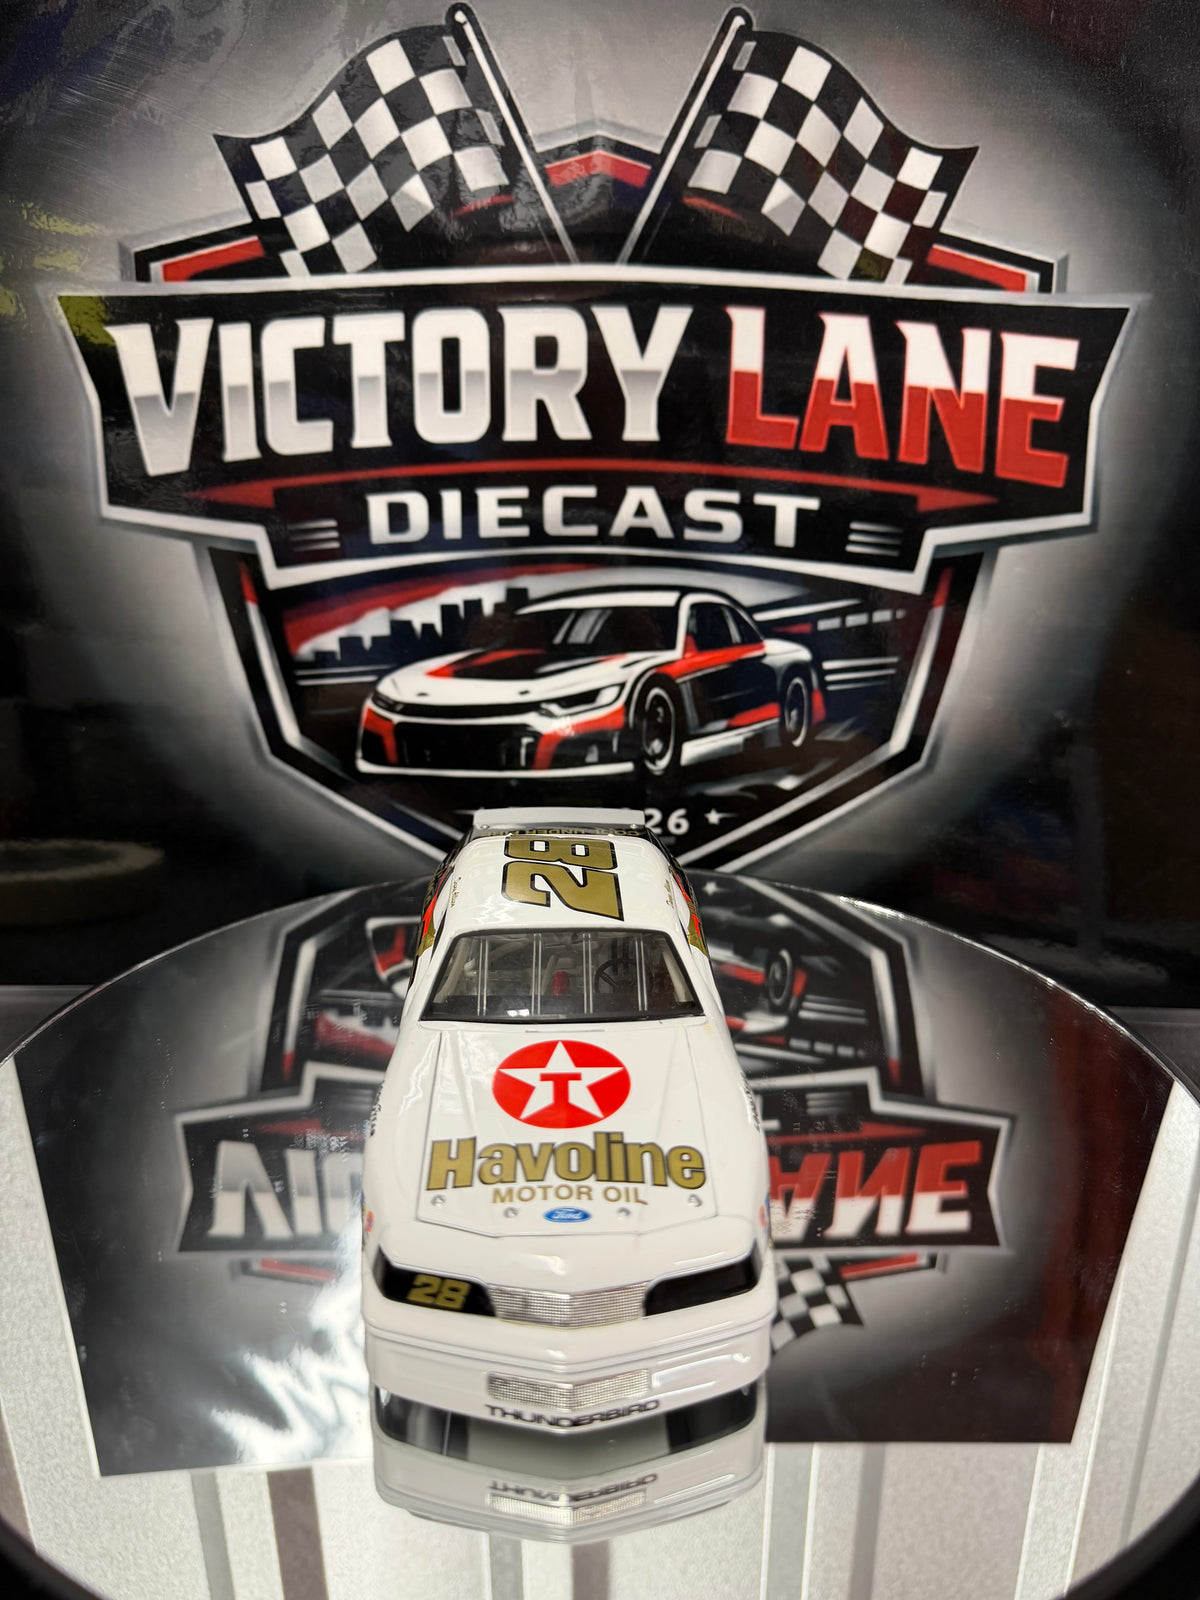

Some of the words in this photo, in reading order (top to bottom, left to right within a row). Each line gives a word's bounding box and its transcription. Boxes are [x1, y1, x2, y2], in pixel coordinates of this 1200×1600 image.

[104, 304, 693, 477] VICTORY
[726, 306, 1080, 488] LANE
[366, 486, 820, 548] DIECAST
[501, 836, 624, 921] 28
[539, 1072, 582, 1105] T
[426, 1131, 706, 1190] Havoline
[492, 1184, 593, 1204] MOTOR
[602, 1187, 648, 1206] OIL
[548, 1207, 587, 1221] Ford
[406, 1274, 470, 1309] 28
[484, 1400, 661, 1428] THUNDERBIRD
